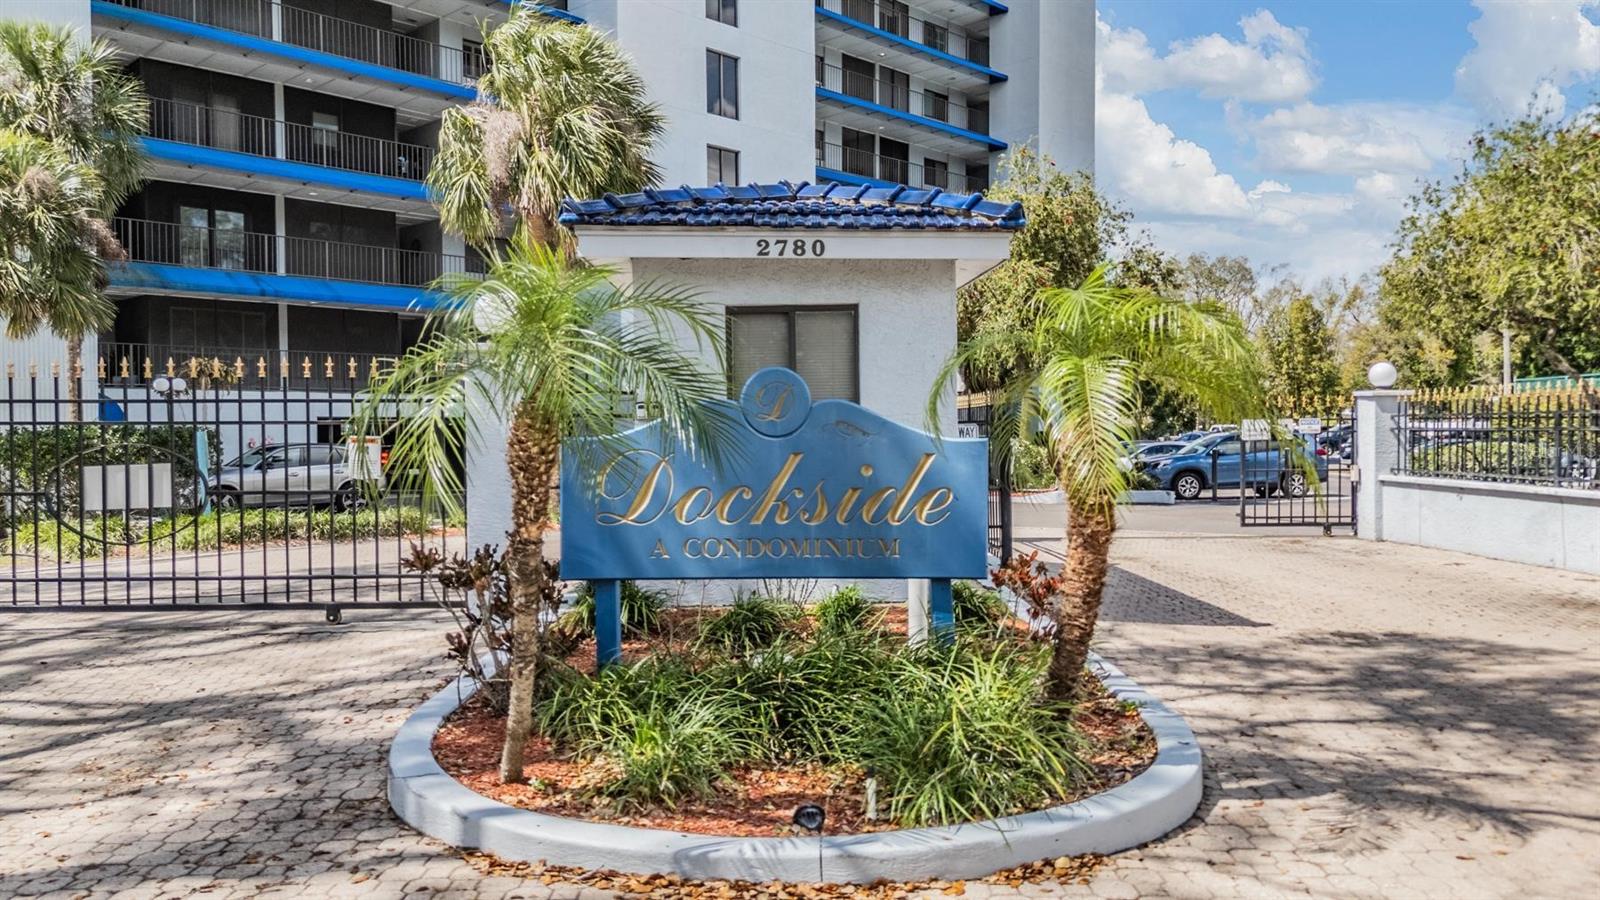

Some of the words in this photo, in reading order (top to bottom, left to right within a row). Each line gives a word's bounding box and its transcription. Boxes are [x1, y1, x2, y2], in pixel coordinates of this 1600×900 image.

[756, 239, 825, 257] 2780
[958, 426, 975, 438] WAY
[596, 450, 954, 526] Dockside
[649, 538, 671, 559] A
[682, 538, 901, 559] CONDOMINIUM
